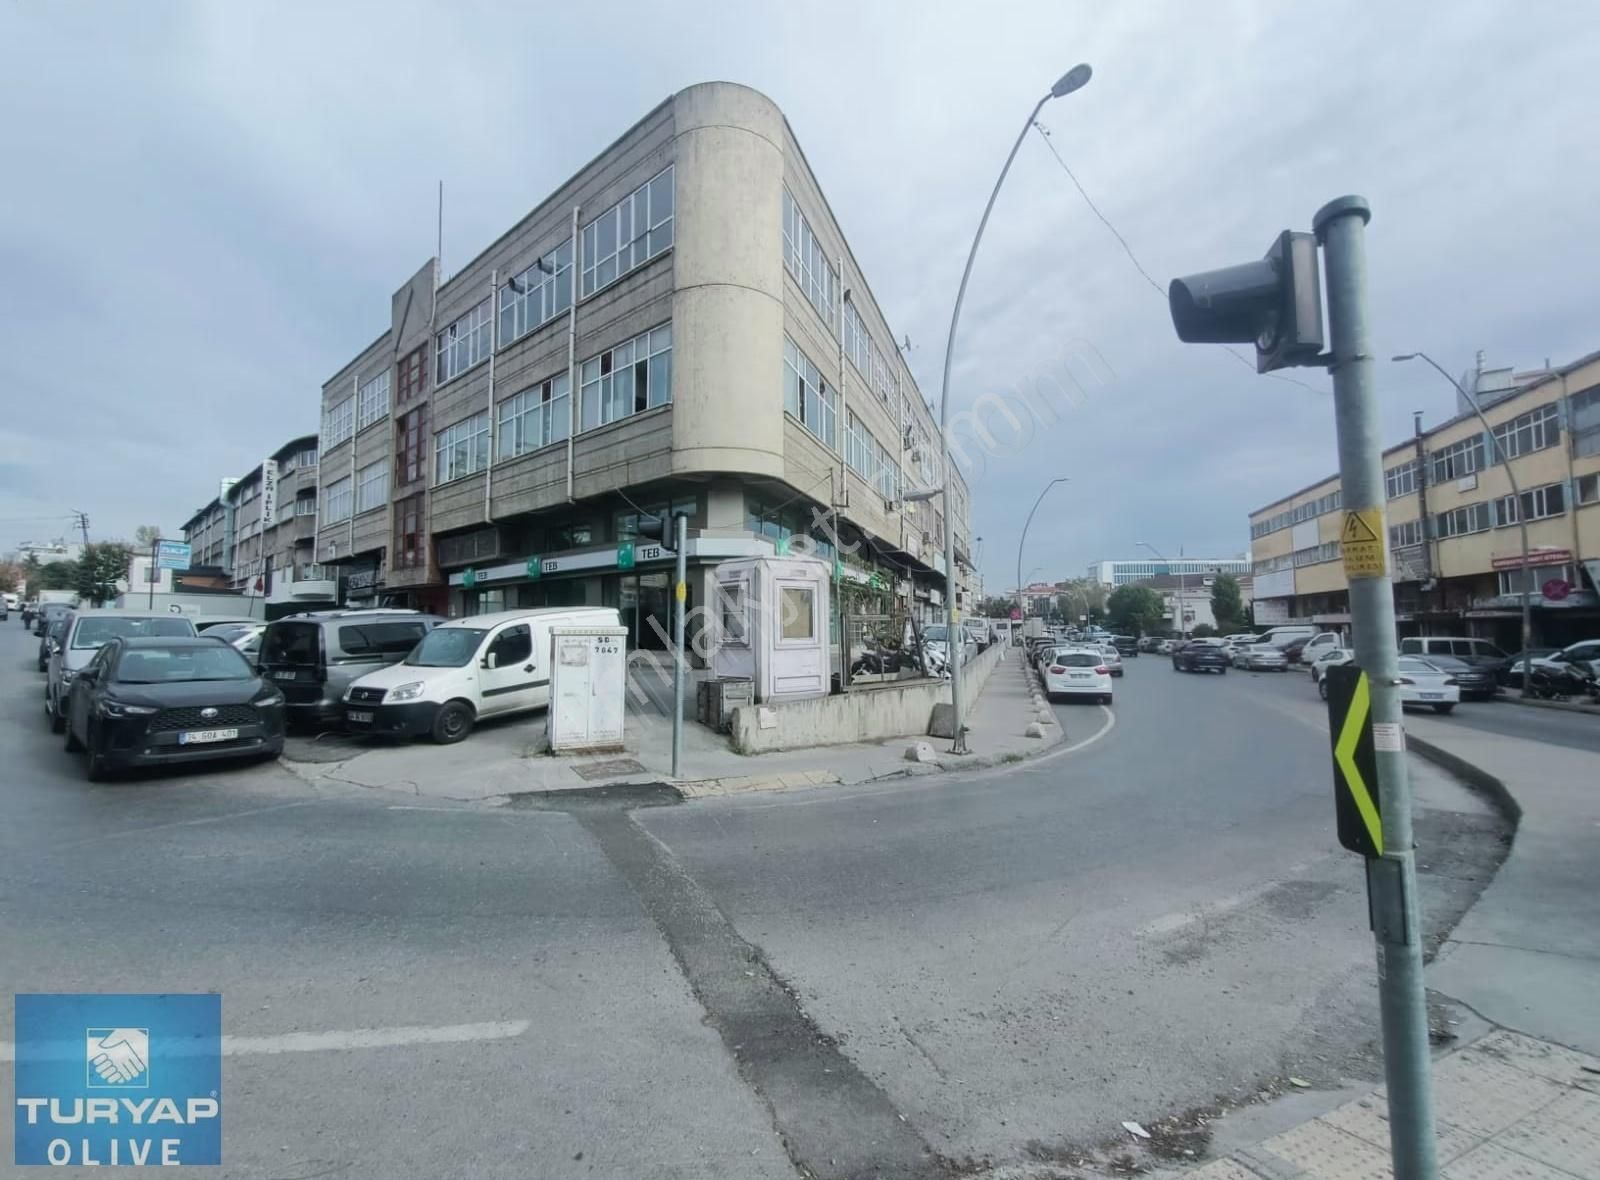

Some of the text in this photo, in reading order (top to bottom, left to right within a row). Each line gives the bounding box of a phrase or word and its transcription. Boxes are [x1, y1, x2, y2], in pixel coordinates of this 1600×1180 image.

[641, 547, 659, 559] TEB
[544, 562, 558, 572] TEB
[477, 571, 488, 580] TEB
